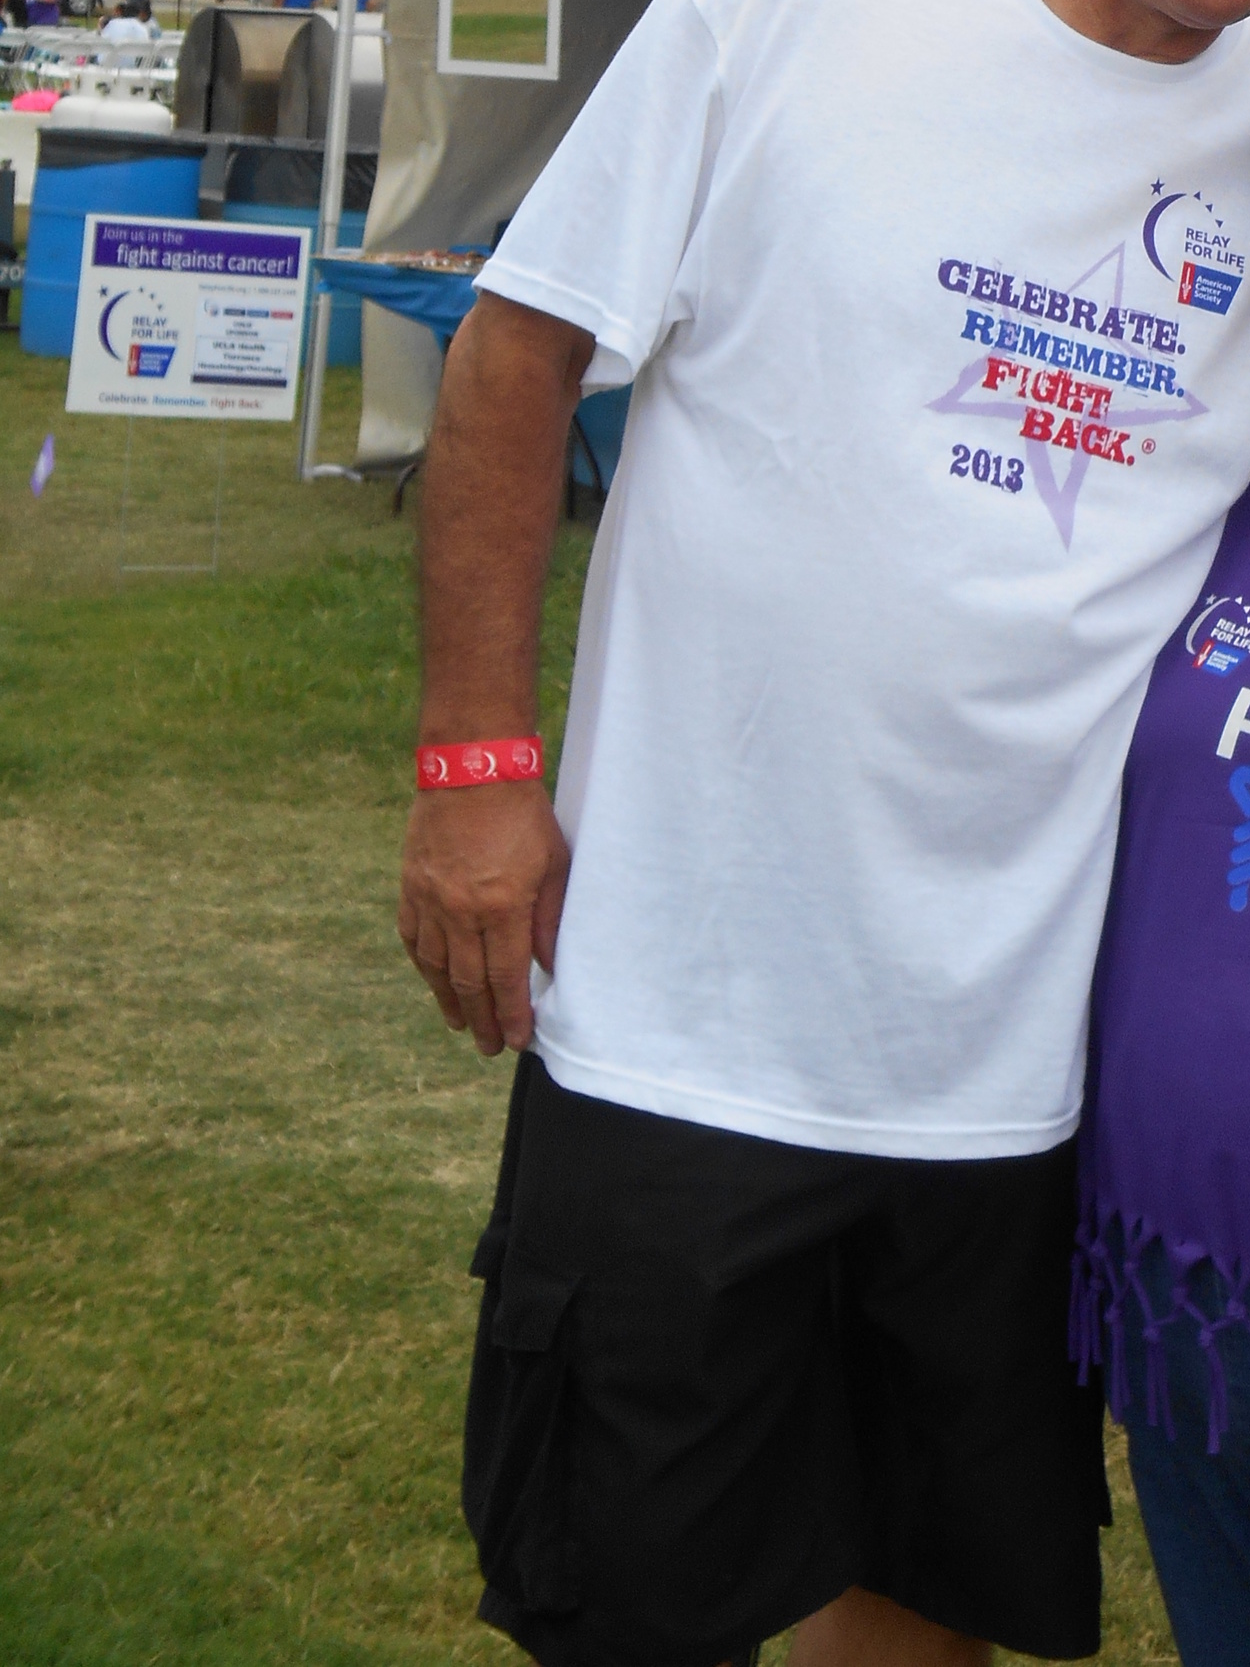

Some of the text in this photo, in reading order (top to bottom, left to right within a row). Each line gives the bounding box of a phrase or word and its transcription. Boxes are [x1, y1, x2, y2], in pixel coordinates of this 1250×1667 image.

[103, 225, 185, 244] Join us in the
[1186, 227, 1231, 248] RELAY
[117, 243, 294, 276] fight against cancer!
[1185, 241, 1246, 270] FOR LIFE
[1195, 282, 1222, 297] Cancer
[1196, 275, 1232, 292] American
[937, 256, 1186, 357] CELEBRATE.
[1194, 290, 1222, 306] Society
[132, 316, 168, 327] RELAY
[960, 309, 1185, 398] REMEMBER.
[981, 356, 1113, 419] FIGHT
[1019, 405, 1135, 466] BACK.
[950, 443, 1025, 494] 2013
[1211, 627, 1234, 644] FOR
